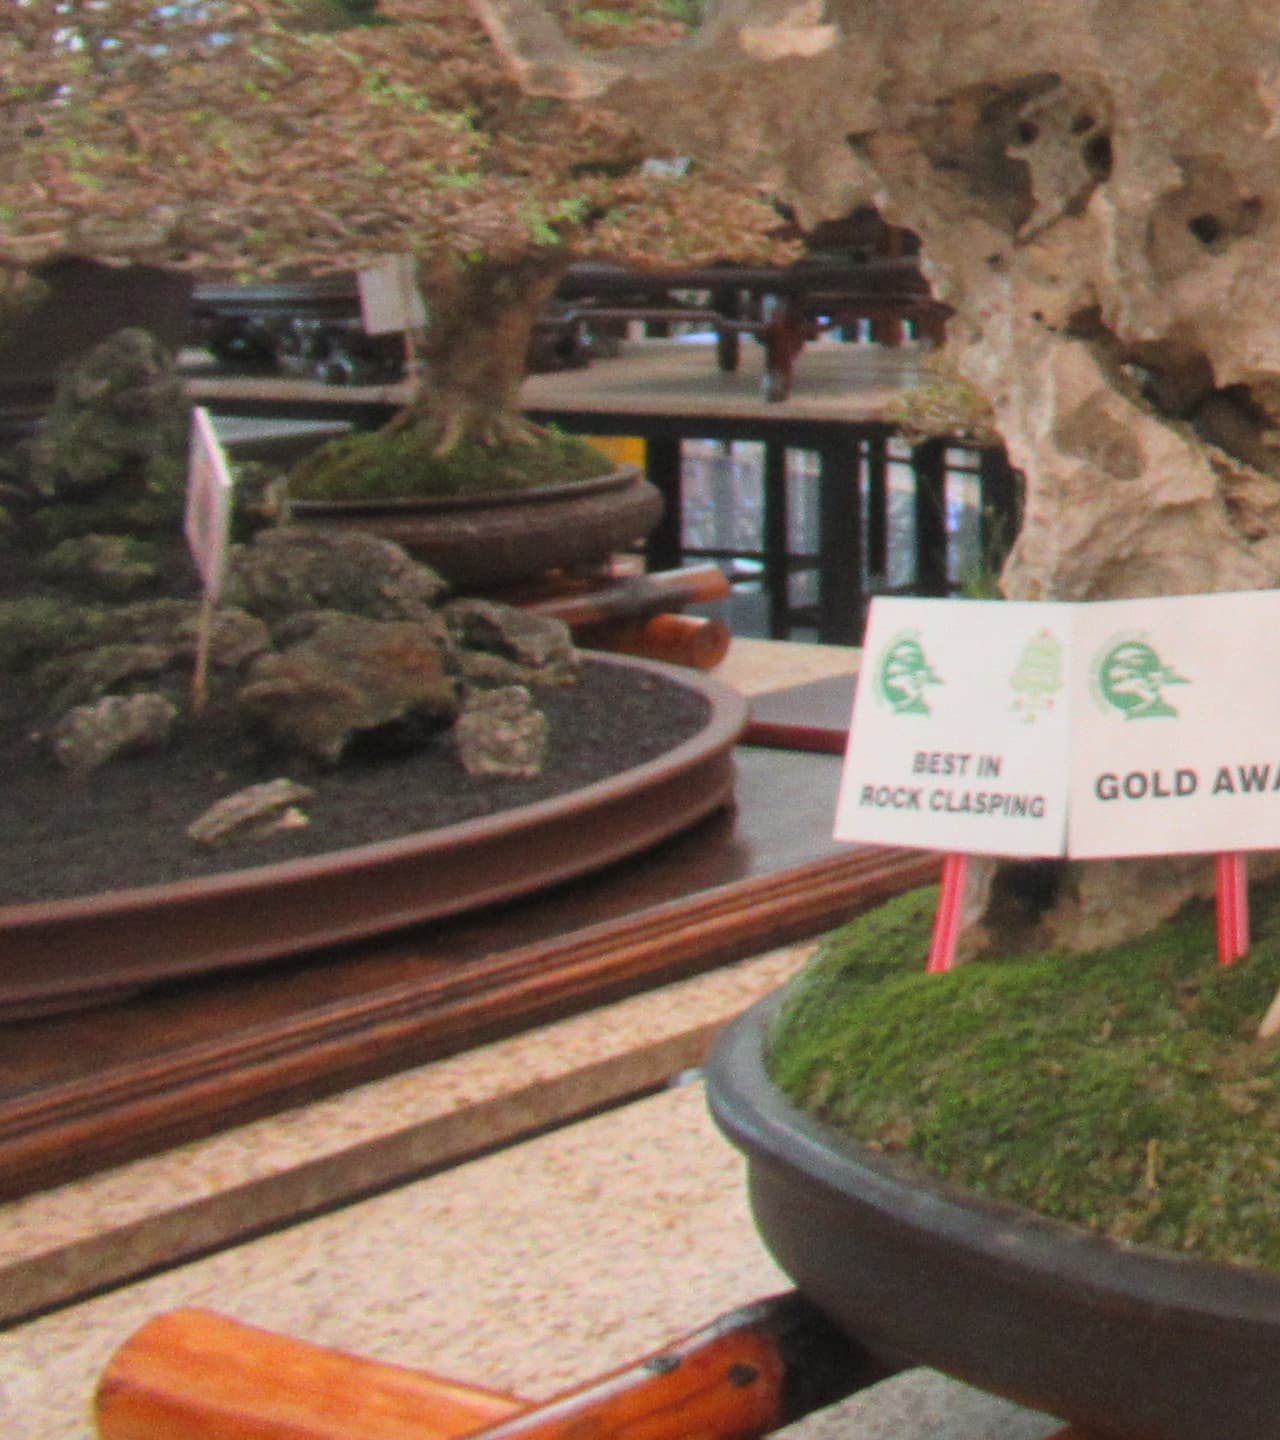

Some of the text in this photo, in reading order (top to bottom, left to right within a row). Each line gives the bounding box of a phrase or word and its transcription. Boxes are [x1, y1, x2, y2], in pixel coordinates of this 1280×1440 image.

[912, 751, 1002, 777] BEST IN
[1095, 768, 1198, 800] GOLD
[860, 785, 1046, 818] ROCK CLASPING
